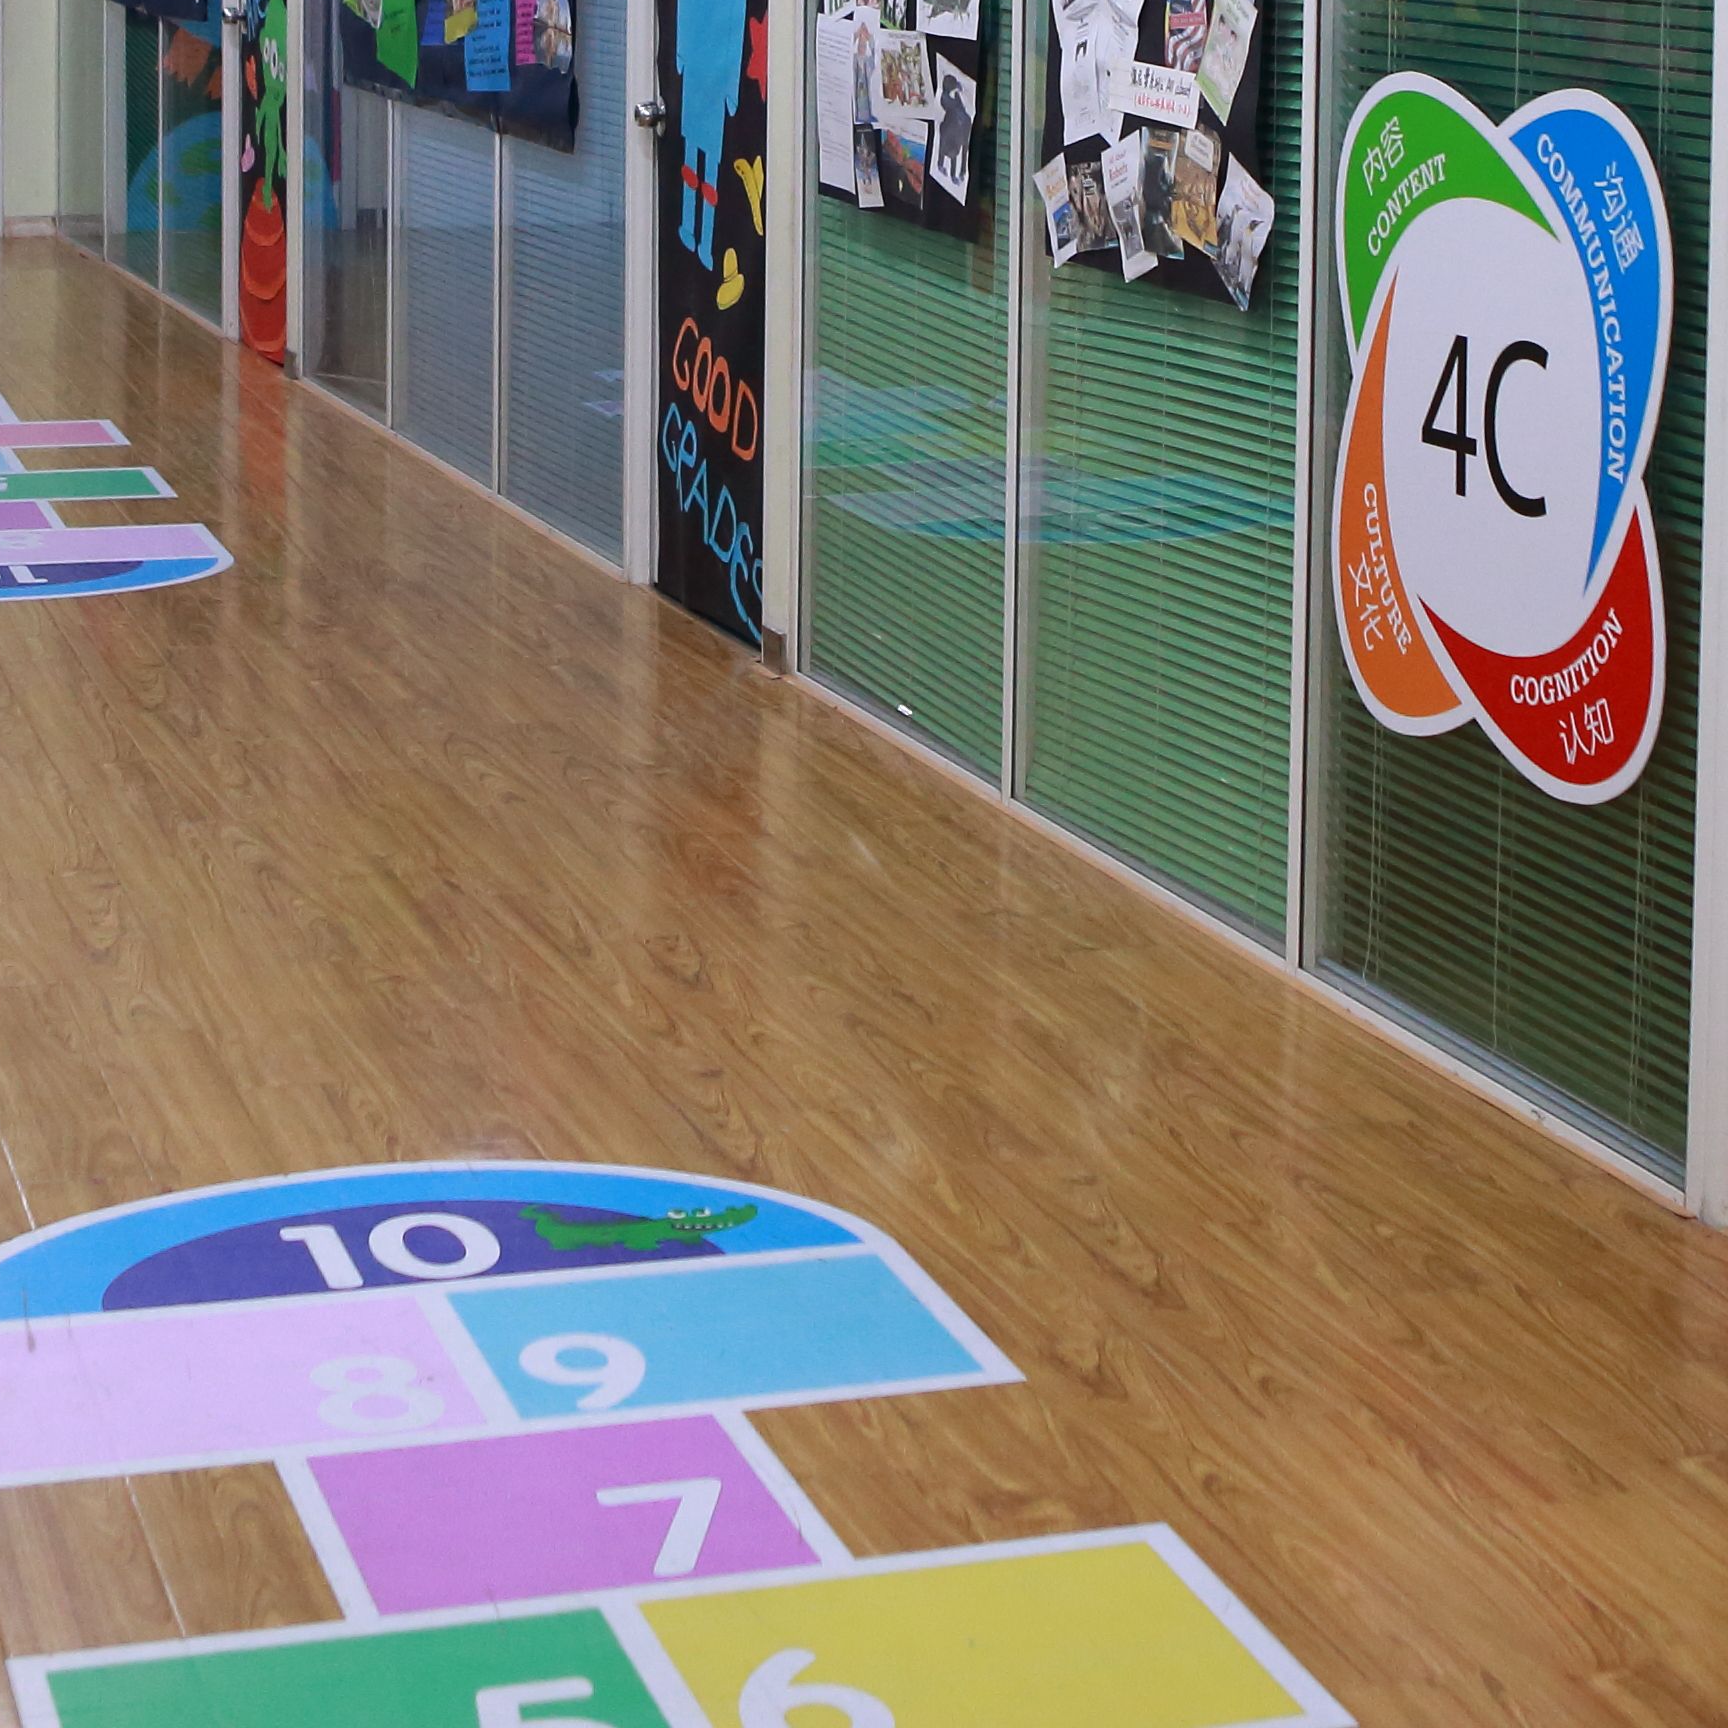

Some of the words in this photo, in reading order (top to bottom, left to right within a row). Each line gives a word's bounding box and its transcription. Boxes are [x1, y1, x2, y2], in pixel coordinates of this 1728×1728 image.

[1362, 116, 1405, 197] 内容
[1368, 153, 1447, 257] CONTENT
[1594, 161, 1645, 276] 沟通
[1537, 134, 1628, 485] COMMUNICATION
[672, 316, 758, 461] GOOD
[1422, 334, 1550, 518] 4C
[1348, 552, 1384, 651] 文化
[1363, 483, 1412, 655] CULTURE
[1510, 608, 1623, 706] COGNITION
[1559, 698, 1615, 765] 认知
[279, 1210, 502, 1293] 10
[308, 1352, 446, 1435] 8
[519, 1331, 646, 1411] 9
[593, 1475, 722, 1579] 7
